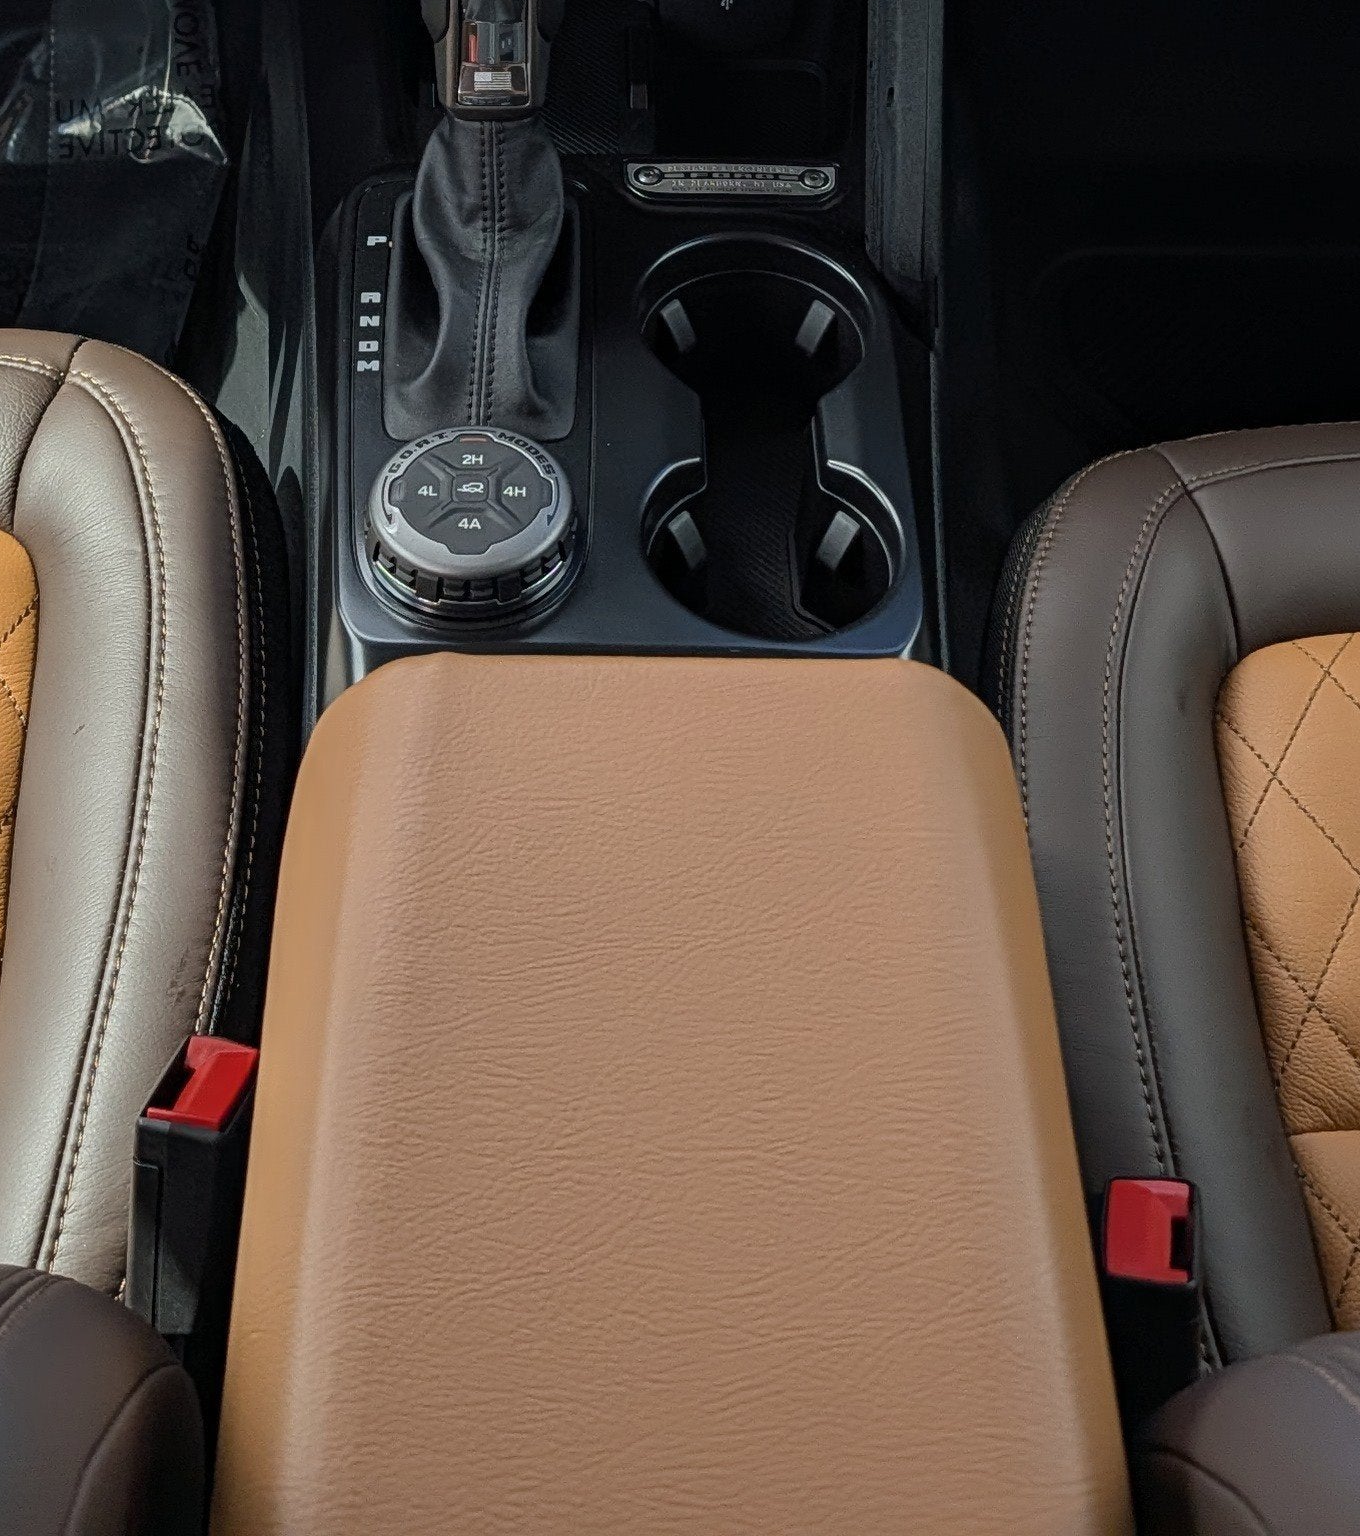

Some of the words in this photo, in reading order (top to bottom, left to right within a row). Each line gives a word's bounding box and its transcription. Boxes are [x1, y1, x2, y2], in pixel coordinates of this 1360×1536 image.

[366, 236, 388, 246] P
[360, 292, 381, 304] R
[359, 316, 380, 327] N
[358, 340, 379, 352] D
[356, 360, 380, 372] M
[462, 454, 484, 465] 2H
[498, 432, 557, 475] MODES
[417, 485, 438, 497] 4L
[502, 486, 527, 497] 4H
[458, 518, 482, 530] 4A
